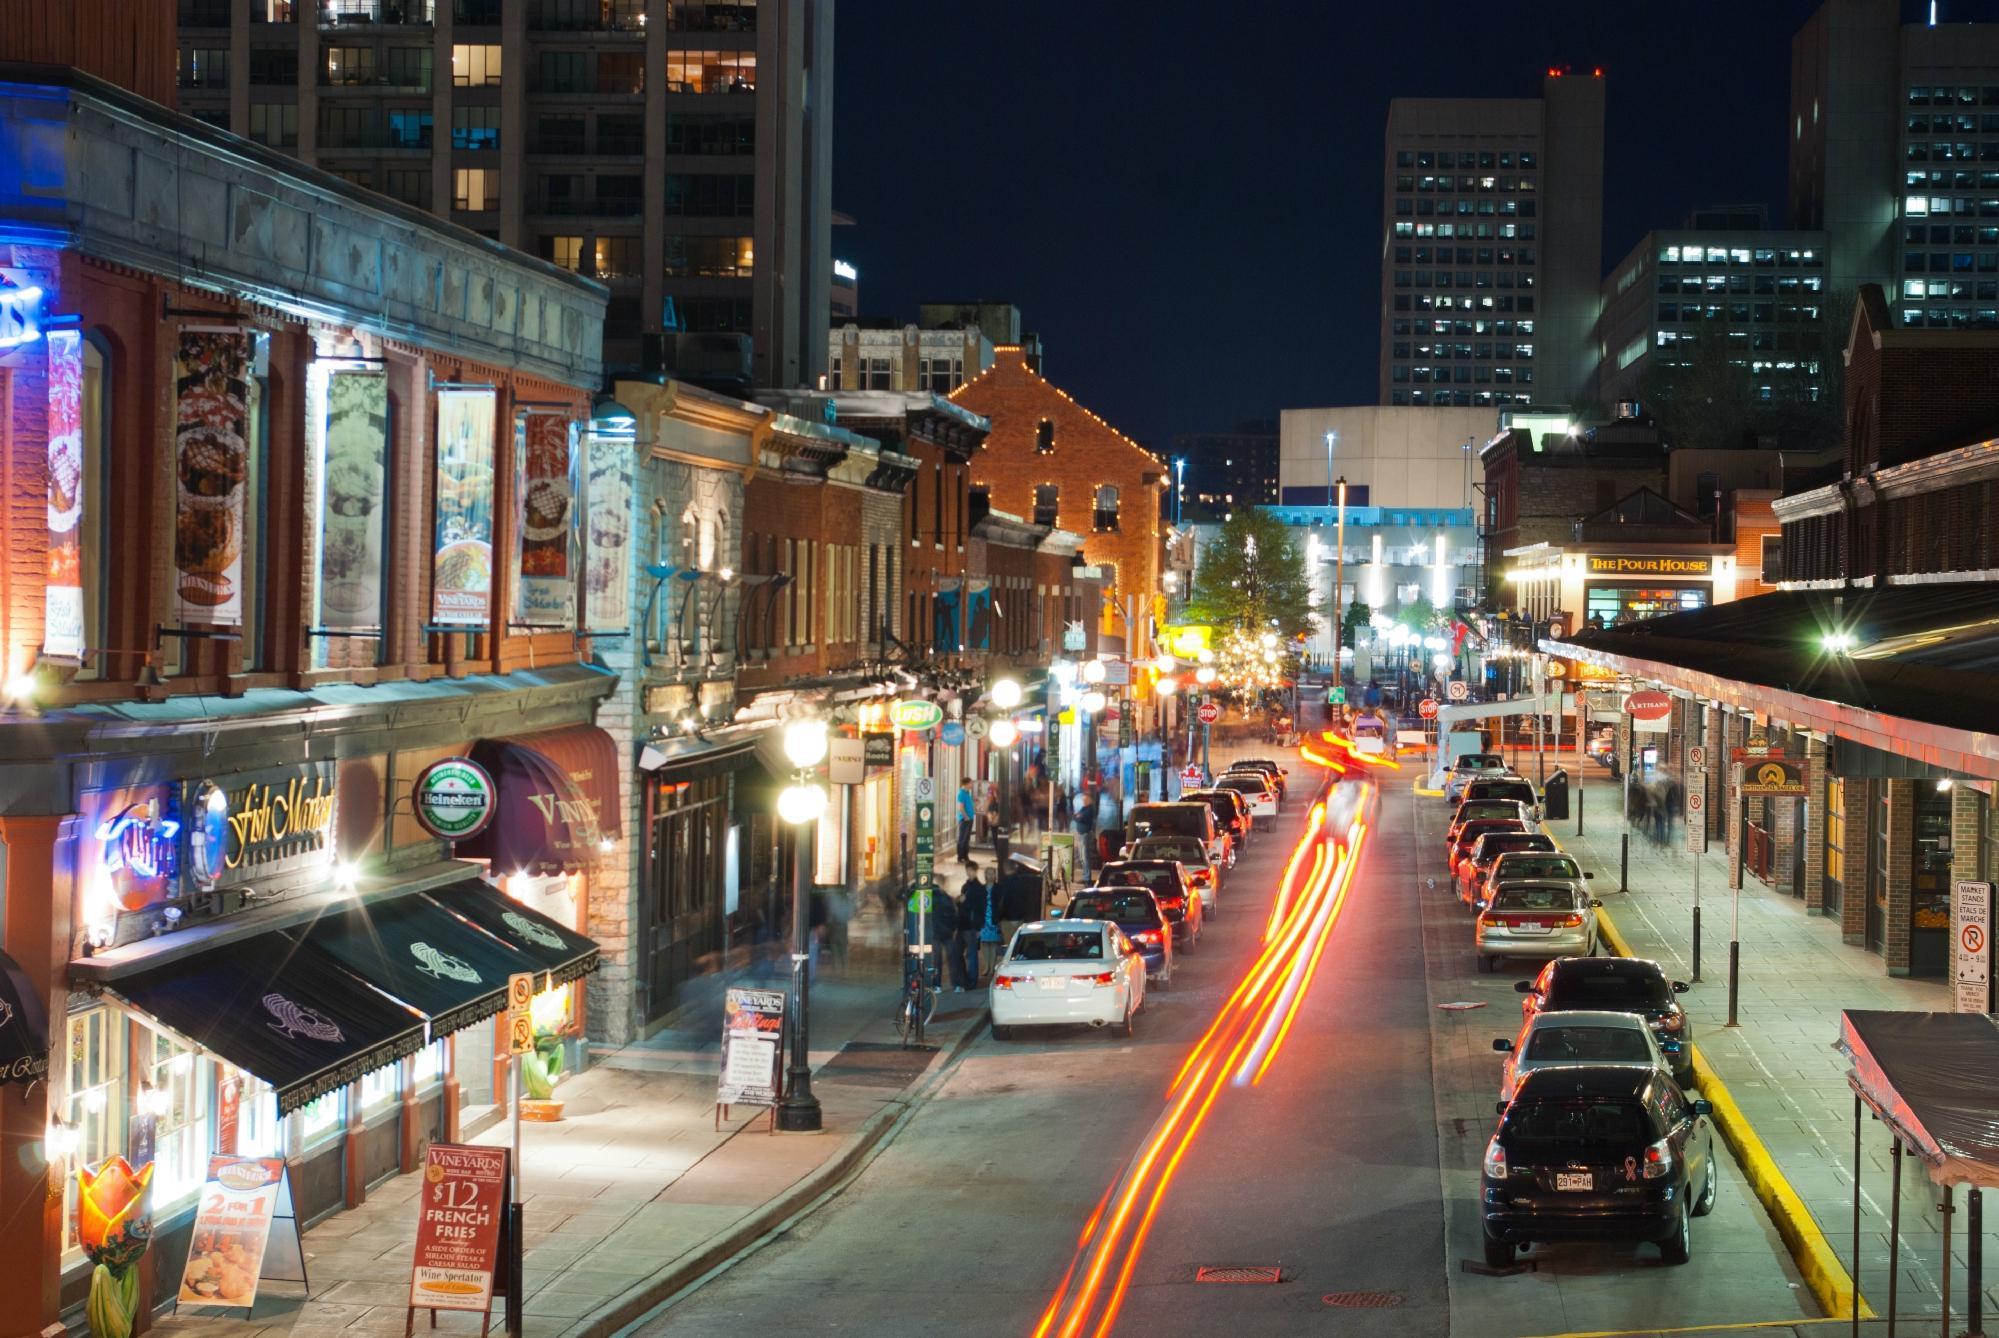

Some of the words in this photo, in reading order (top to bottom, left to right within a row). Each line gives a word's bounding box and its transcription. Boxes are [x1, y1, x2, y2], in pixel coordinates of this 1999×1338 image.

[1590, 558, 1616, 570] THE
[1617, 558, 1658, 571] POUR
[1660, 559, 1707, 571] HOUSE
[1420, 704, 1437, 713] STOP
[1627, 700, 1668, 710] ARTISANS
[896, 706, 935, 722] LUSH
[1200, 708, 1217, 718] STOP
[424, 793, 482, 806] Heineken
[1961, 886, 1985, 894] MARKET
[1962, 895, 1985, 903] STANDS
[1979, 907, 1986, 915] DE
[431, 1151, 501, 1171] VINEYARDS
[1558, 1177, 1573, 1187] 291
[205, 1194, 225, 1215] 2
[249, 1197, 268, 1216] 1
[426, 1209, 490, 1226] FRENCH
[435, 1225, 477, 1239] FRIES
[449, 1246, 475, 1254] ORDER
[425, 1252, 455, 1261] SIRLOIN
[456, 1254, 479, 1262] STEAK
[428, 1260, 456, 1268] CAESAR
[420, 1269, 442, 1279] Wine
[443, 1270, 485, 1283] Spectator
